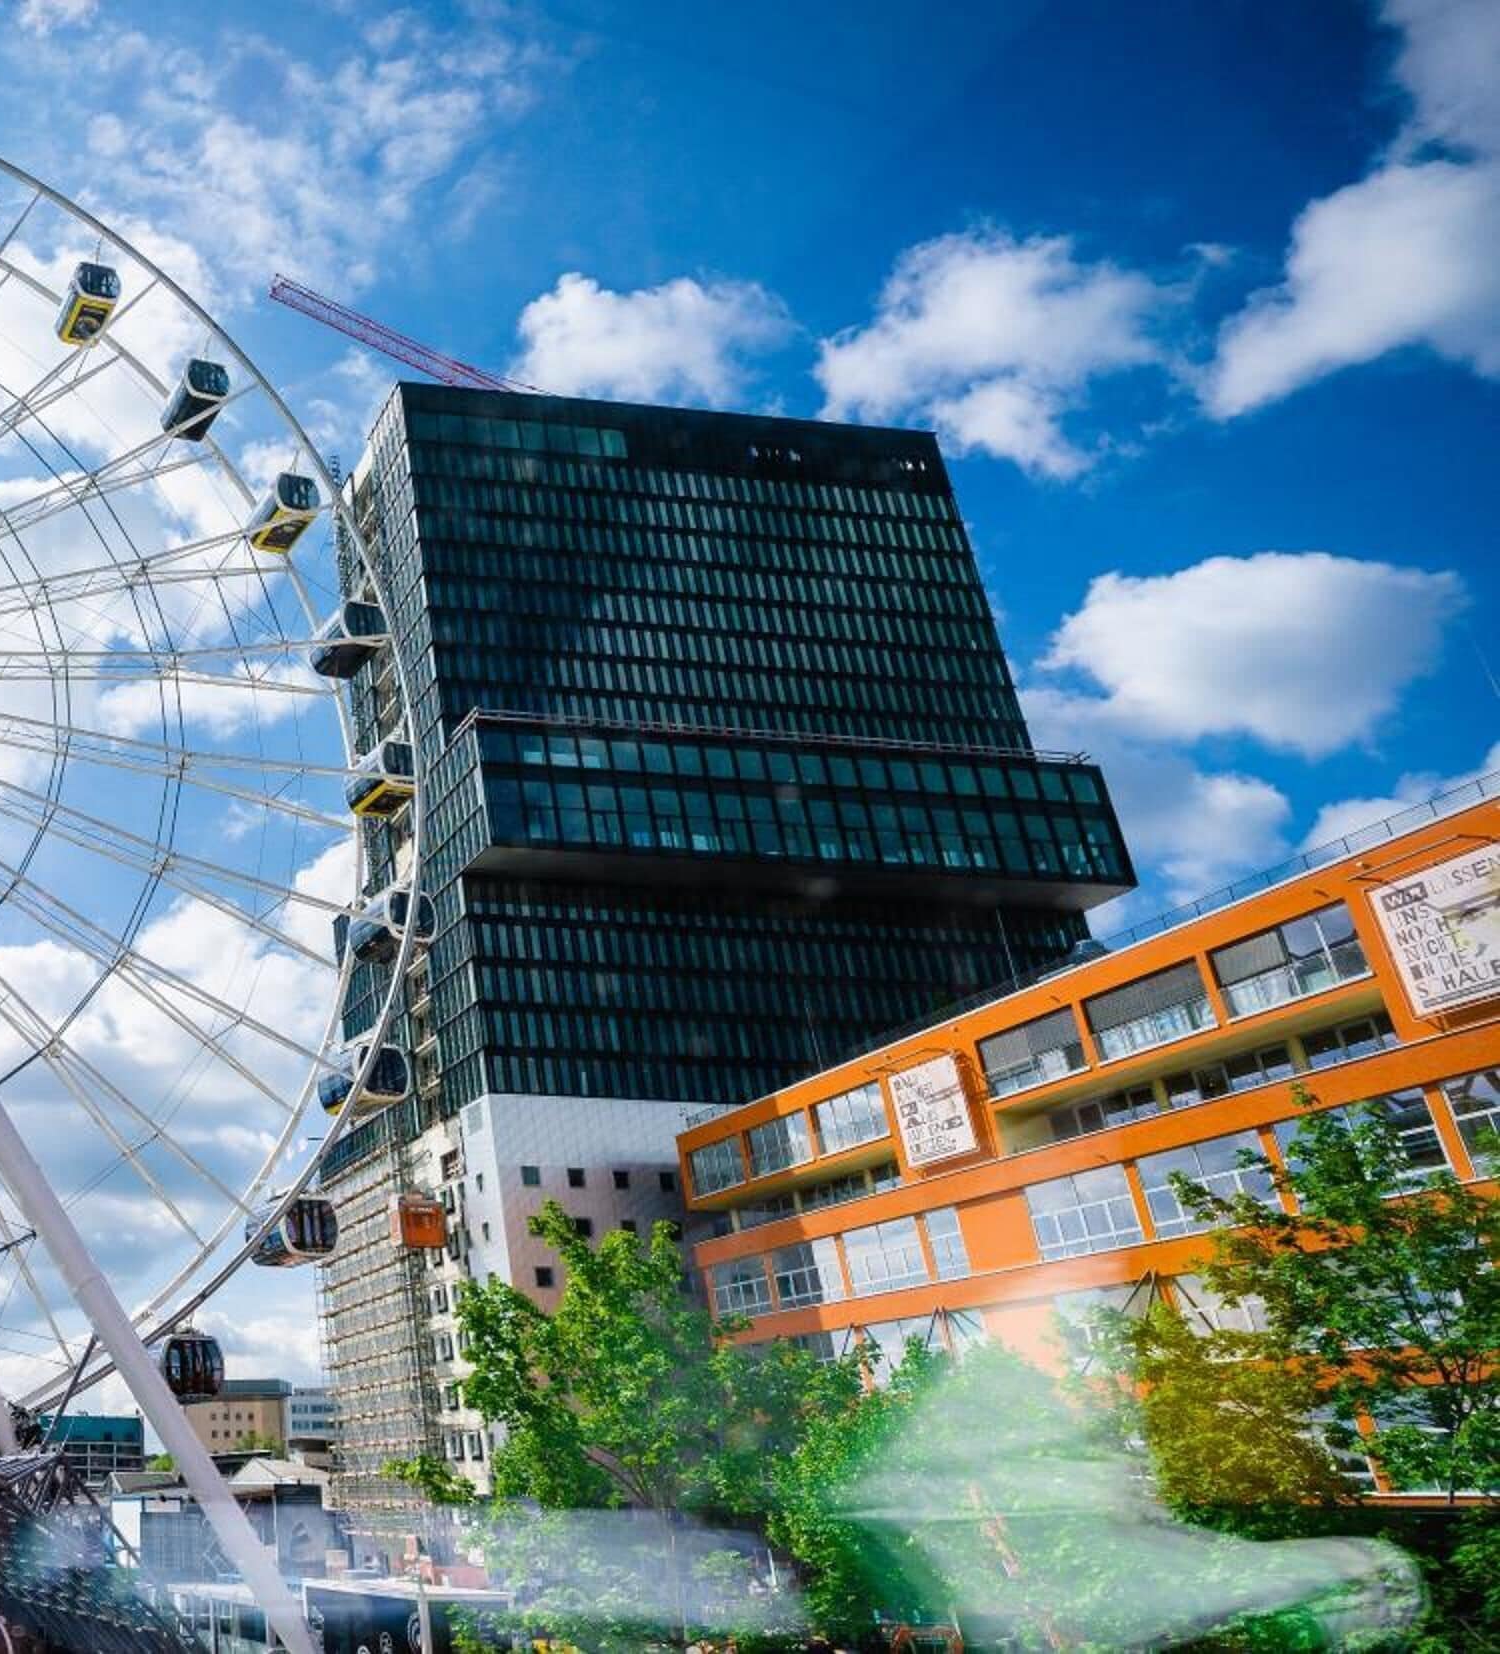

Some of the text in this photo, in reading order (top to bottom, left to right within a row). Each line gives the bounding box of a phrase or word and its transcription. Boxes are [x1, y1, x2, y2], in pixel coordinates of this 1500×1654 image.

[1388, 903, 1429, 928] UNS
[1396, 914, 1452, 947] NOCH
[1403, 929, 1467, 963] NICHT
[1416, 959, 1500, 999] SHAUE
